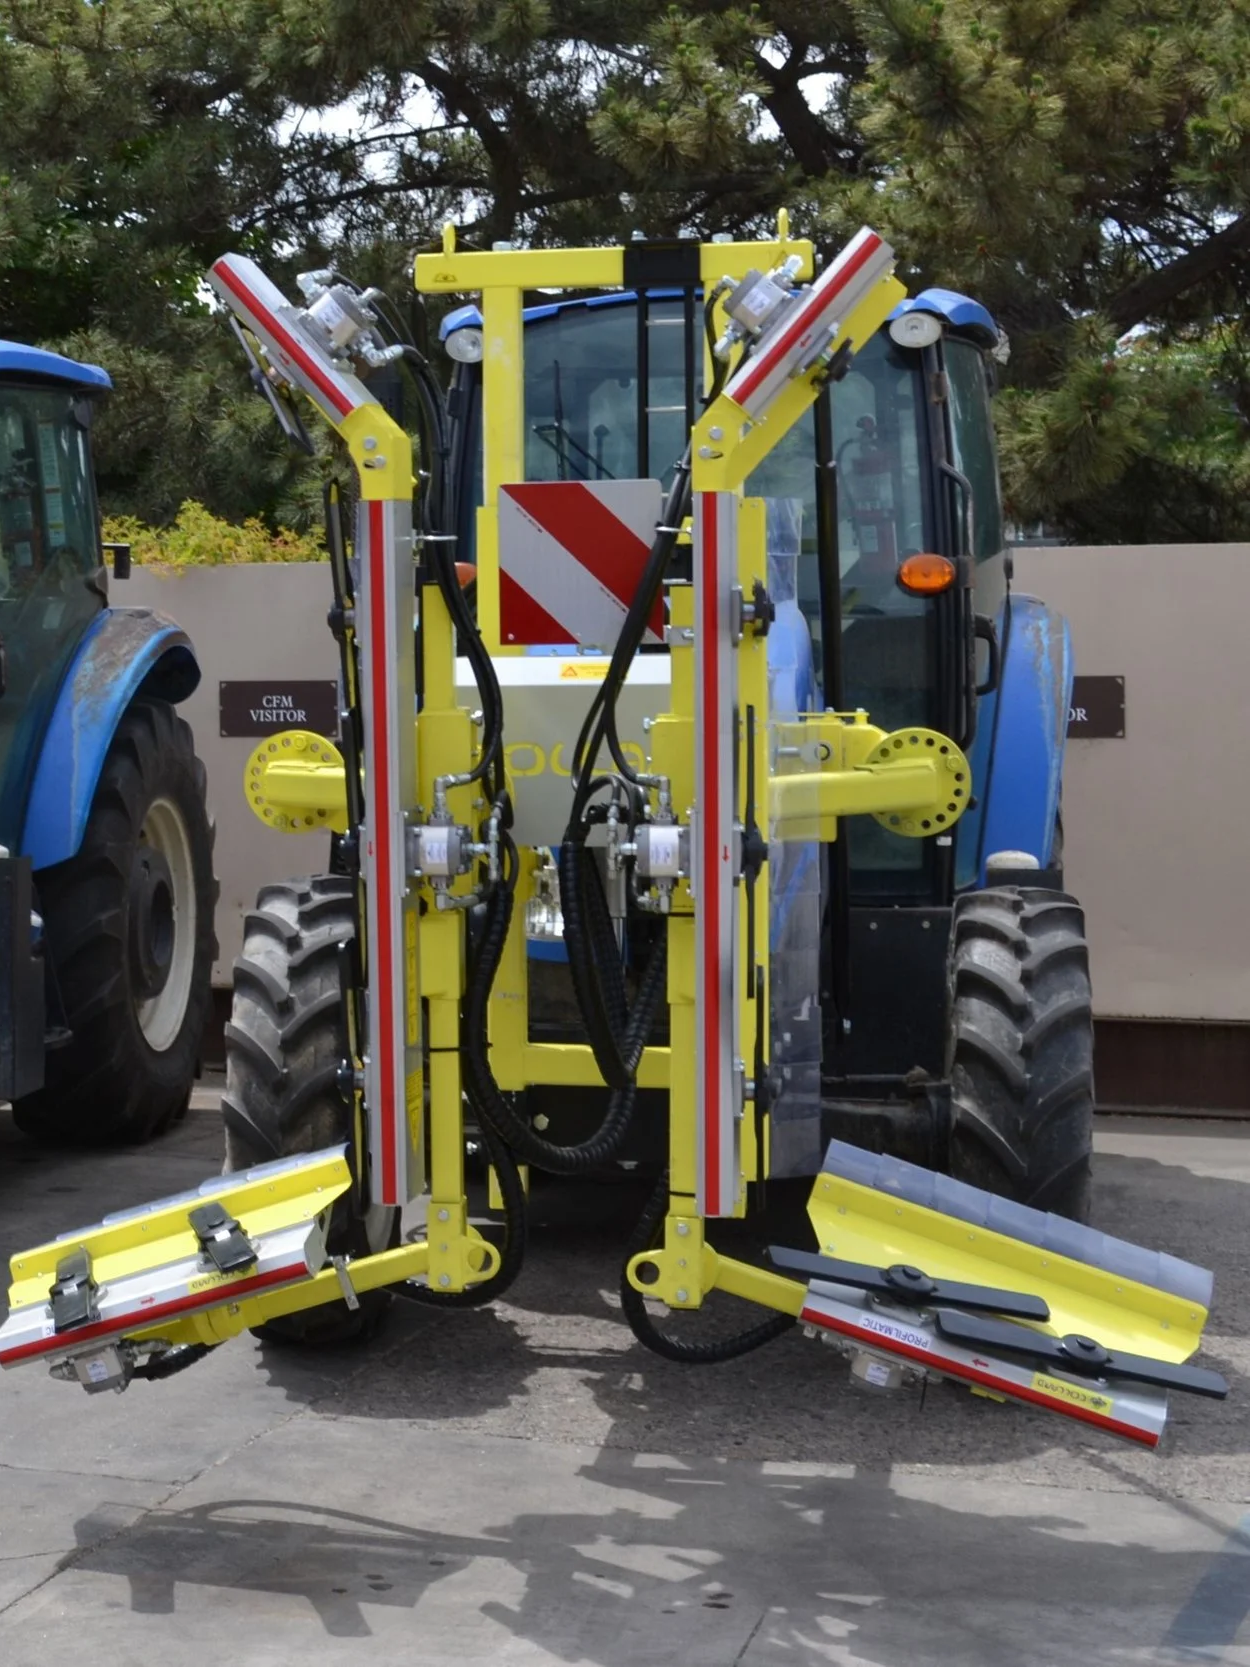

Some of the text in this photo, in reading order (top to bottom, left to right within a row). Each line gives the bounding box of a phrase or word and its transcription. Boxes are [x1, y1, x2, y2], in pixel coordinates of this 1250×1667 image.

[261, 695, 294, 708] CFM
[249, 709, 307, 722] VISITOR
[862, 1318, 930, 1349] PROFILMATIC
